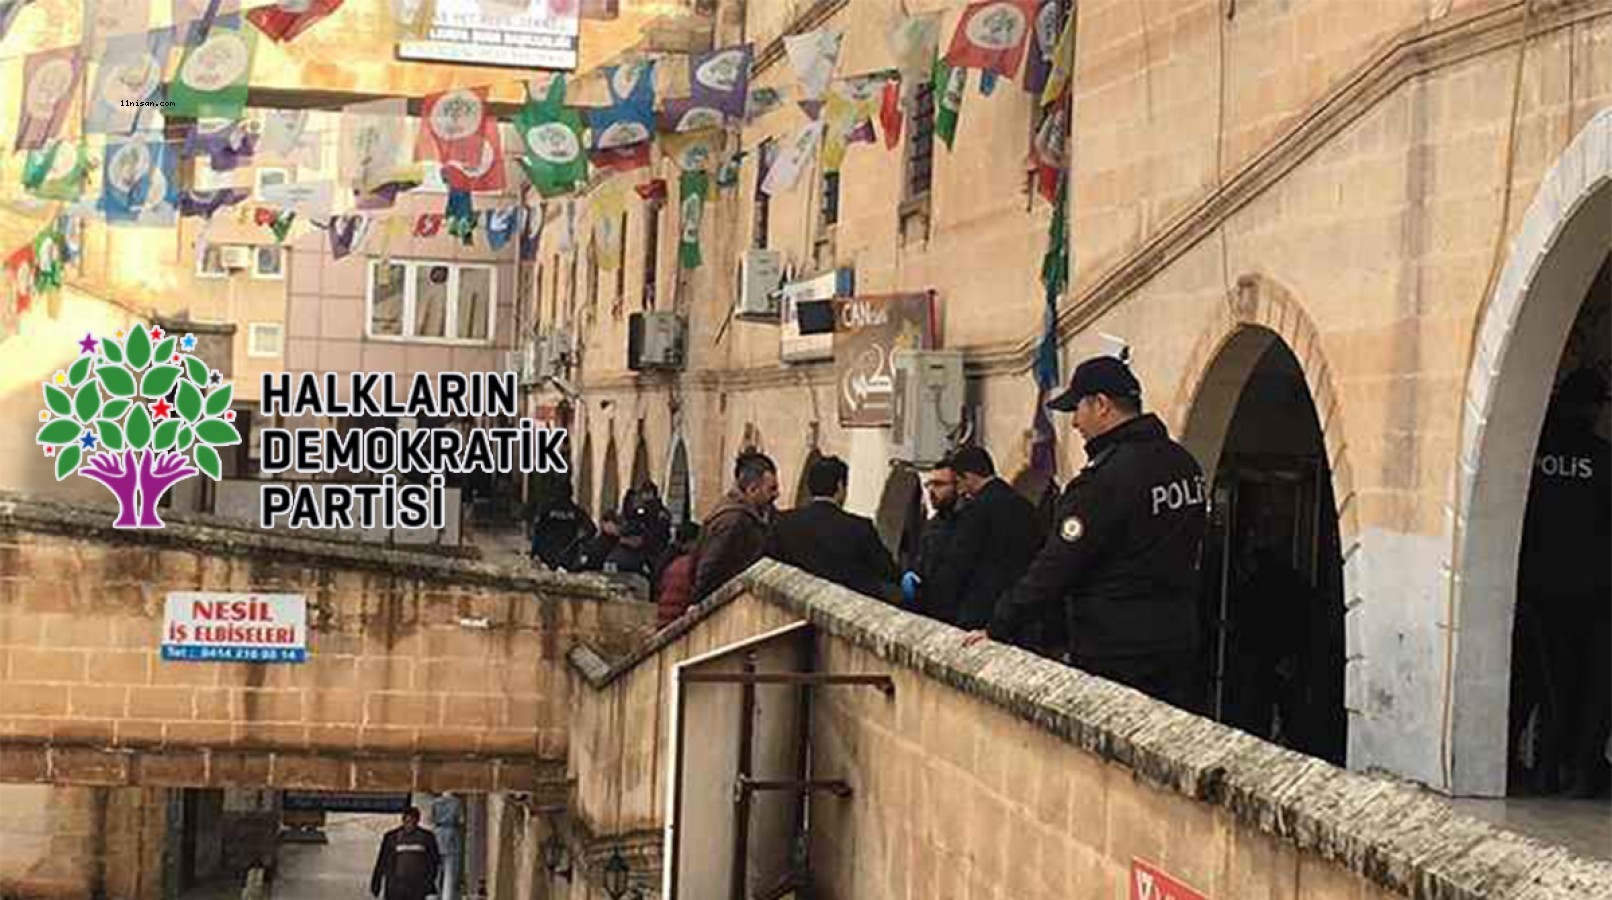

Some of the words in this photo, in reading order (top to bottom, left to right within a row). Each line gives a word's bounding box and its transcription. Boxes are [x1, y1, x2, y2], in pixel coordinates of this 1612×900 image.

[1537, 453, 1594, 479] OLiS
[192, 597, 274, 622] NESİL
[169, 620, 188, 643] İŞ
[194, 623, 296, 644] ELBİSELERİ
